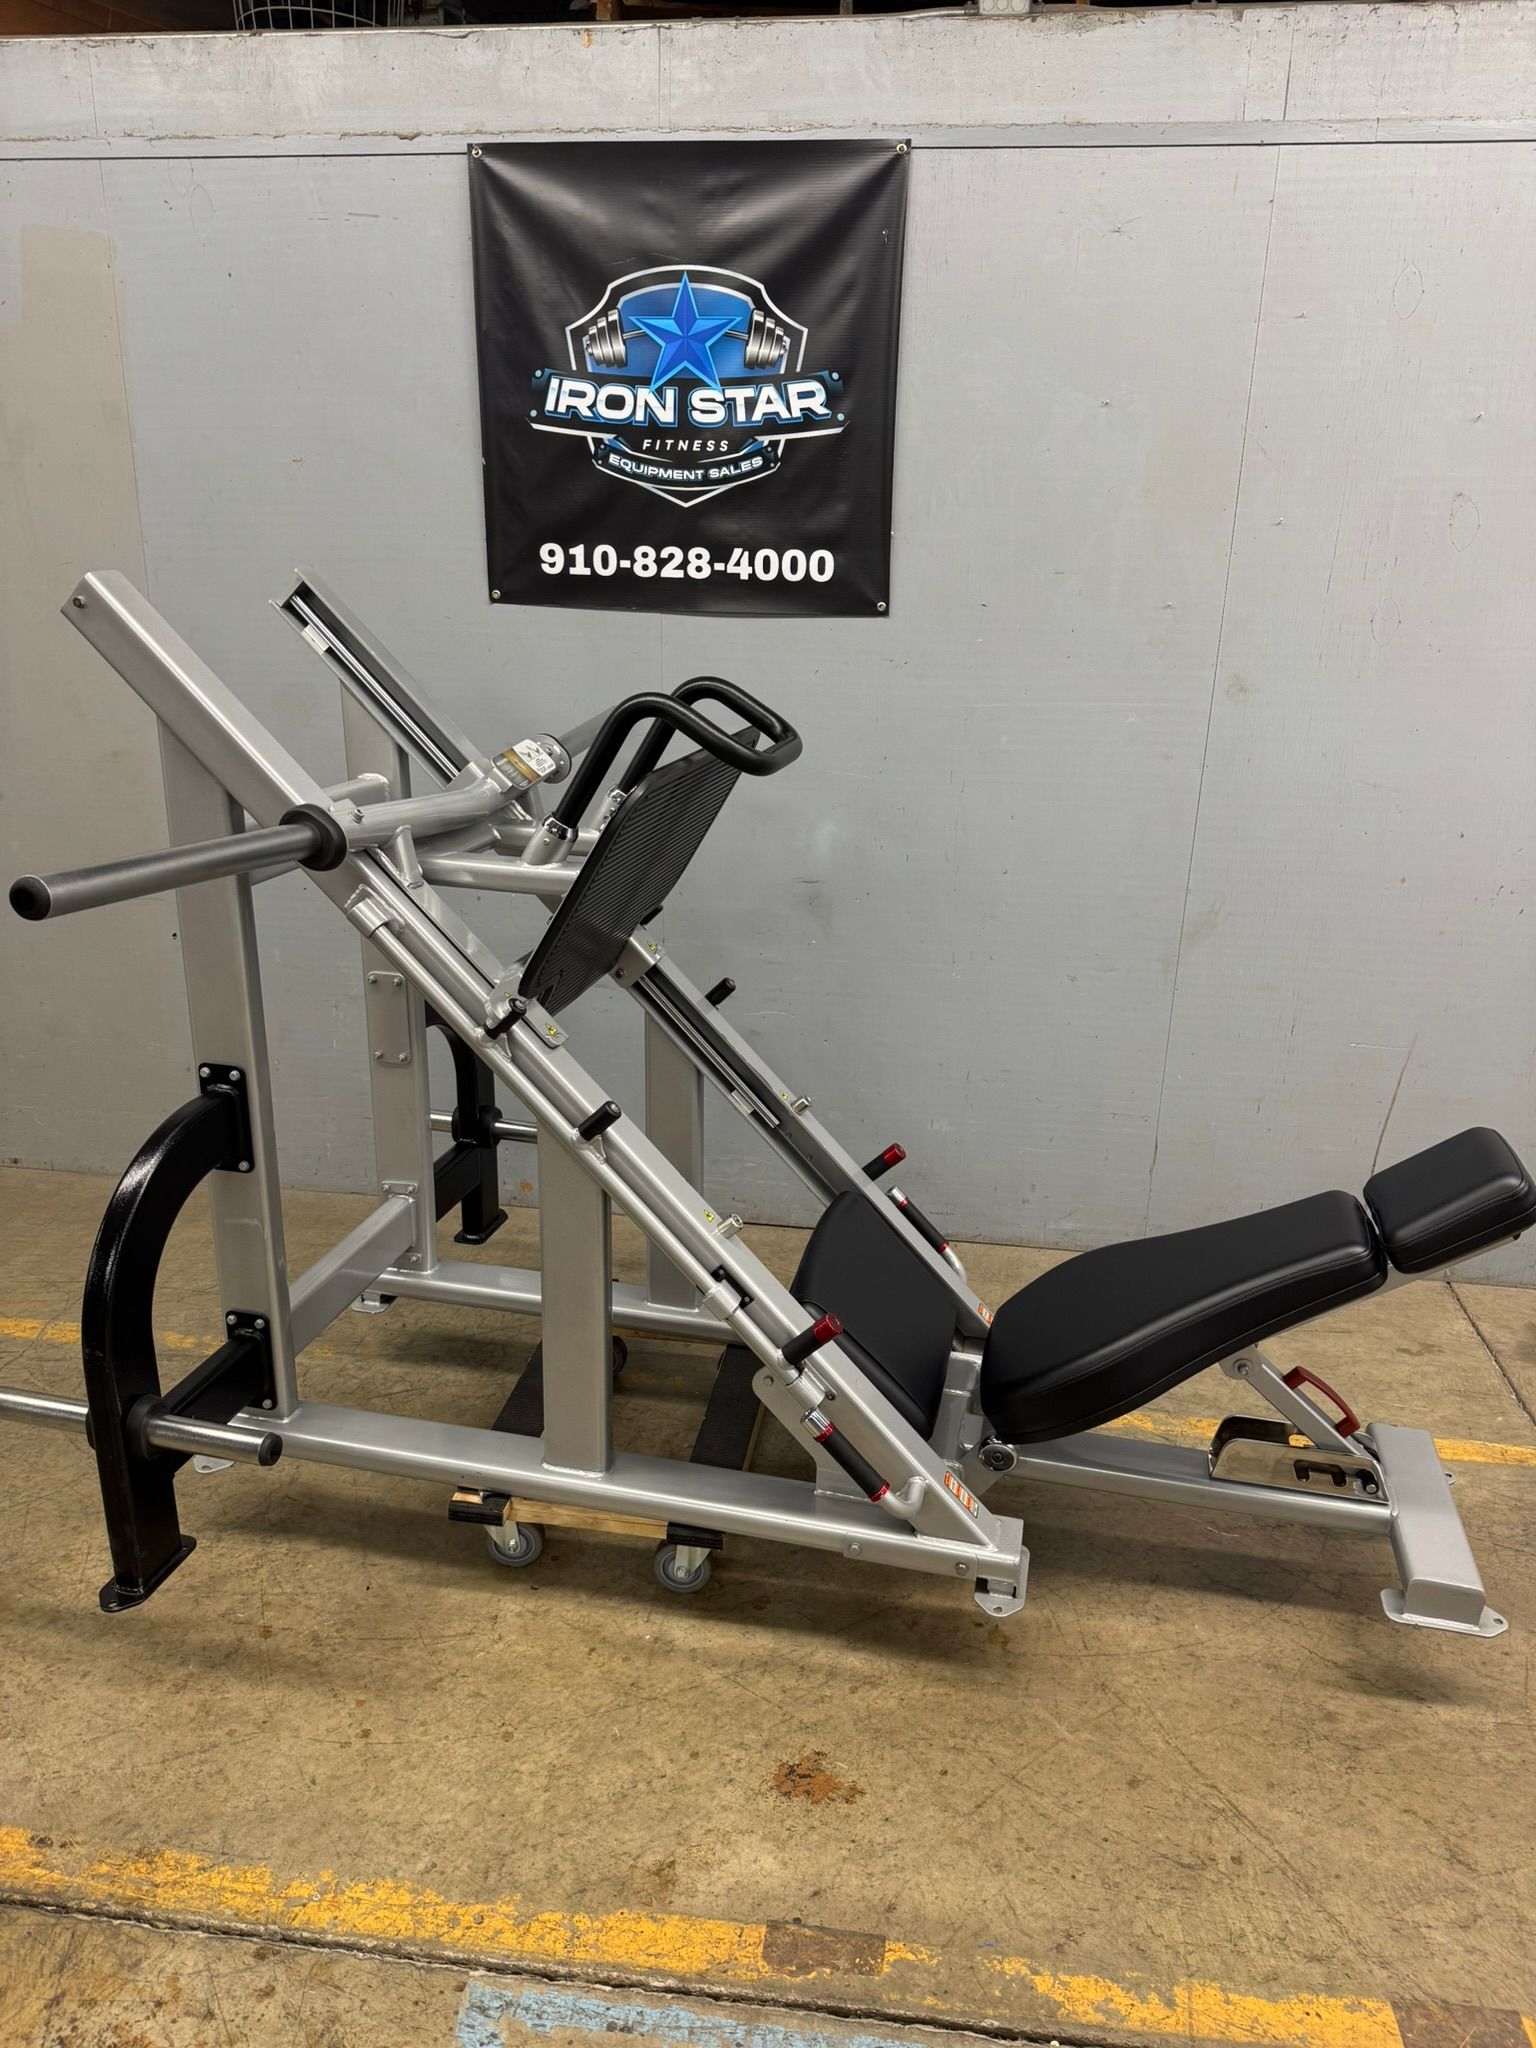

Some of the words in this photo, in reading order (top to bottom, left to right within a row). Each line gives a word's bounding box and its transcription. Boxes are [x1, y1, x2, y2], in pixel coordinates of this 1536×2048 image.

[545, 377, 677, 426] IRON
[689, 380, 831, 426] STAR
[642, 439, 729, 452] FITNESS
[608, 454, 704, 480] EQUIPMENT
[709, 456, 764, 479] SALES
[539, 543, 835, 582] 910-828-4000
